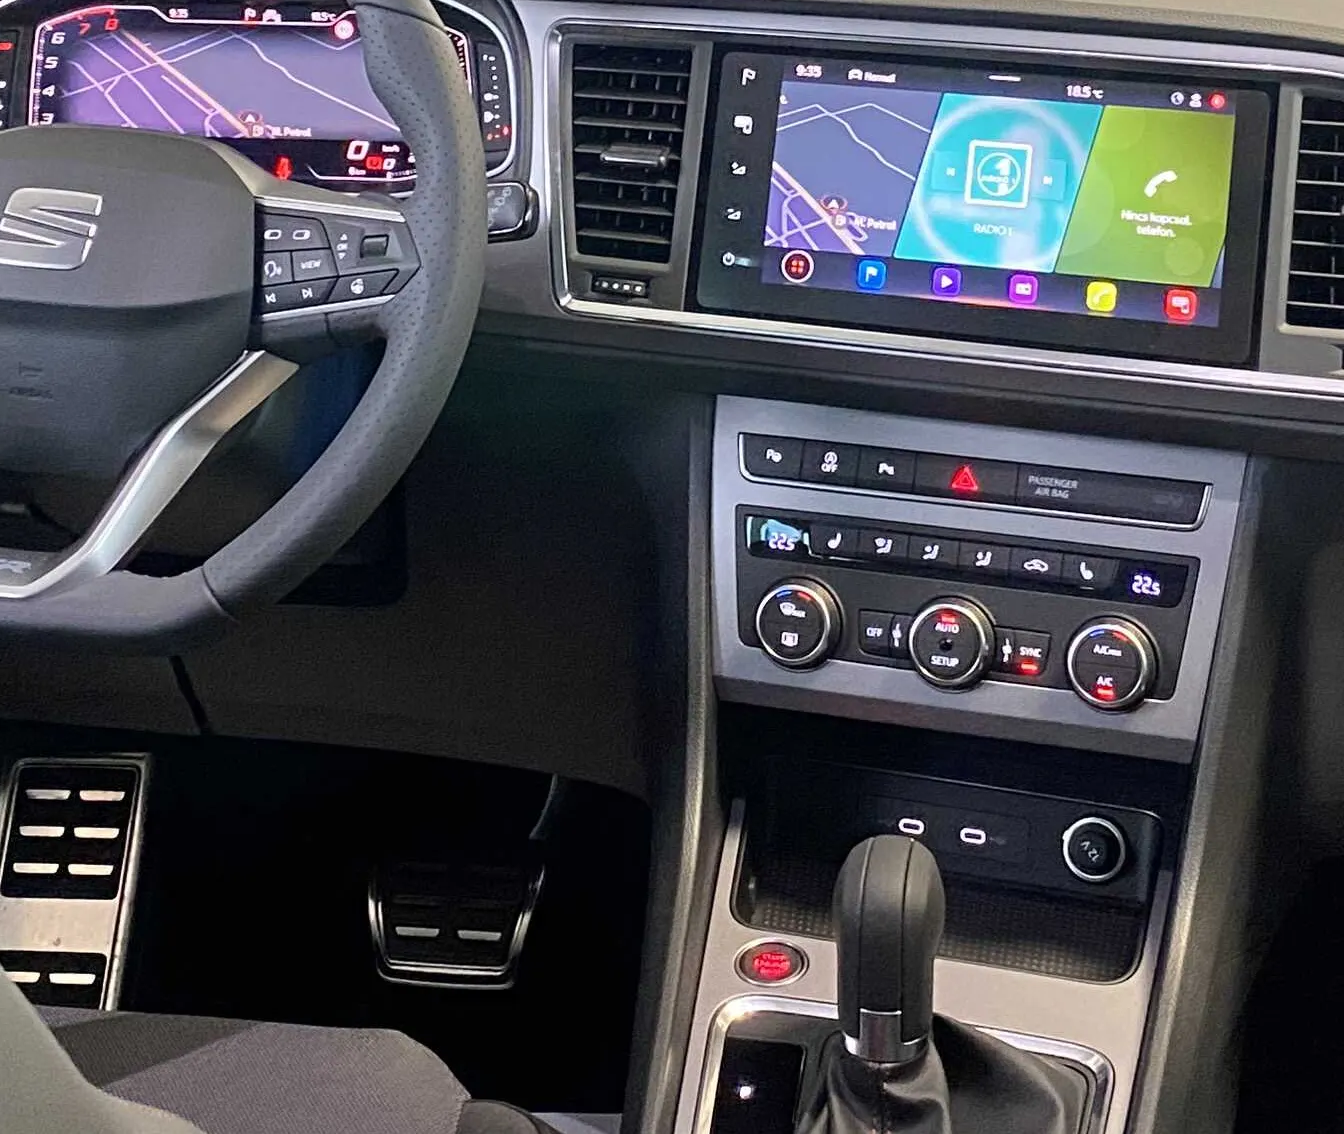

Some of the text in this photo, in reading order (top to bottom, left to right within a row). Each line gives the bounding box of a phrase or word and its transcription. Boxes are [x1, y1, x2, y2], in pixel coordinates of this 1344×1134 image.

[79, 23, 91, 35] 7
[51, 32, 65, 45] 6
[44, 56, 59, 70] 5
[795, 64, 823, 79] 9:35
[42, 85, 56, 97] 4
[40, 113, 55, 126] 3
[346, 140, 370, 161] 0
[1120, 209, 1148, 222] Nincs
[973, 223, 1008, 236] RADIO
[1136, 225, 1177, 238] telefon.
[300, 259, 323, 270] VIEW
[821, 463, 839, 473] OFF
[1028, 475, 1079, 489] PASSENGER
[1034, 487, 1070, 499] AIR BAG
[866, 627, 884, 638] OFF
[934, 622, 960, 634] AUTO
[1019, 646, 1043, 658] SYNC
[930, 655, 960, 668] SETUP
[1096, 675, 1114, 687] A/C
